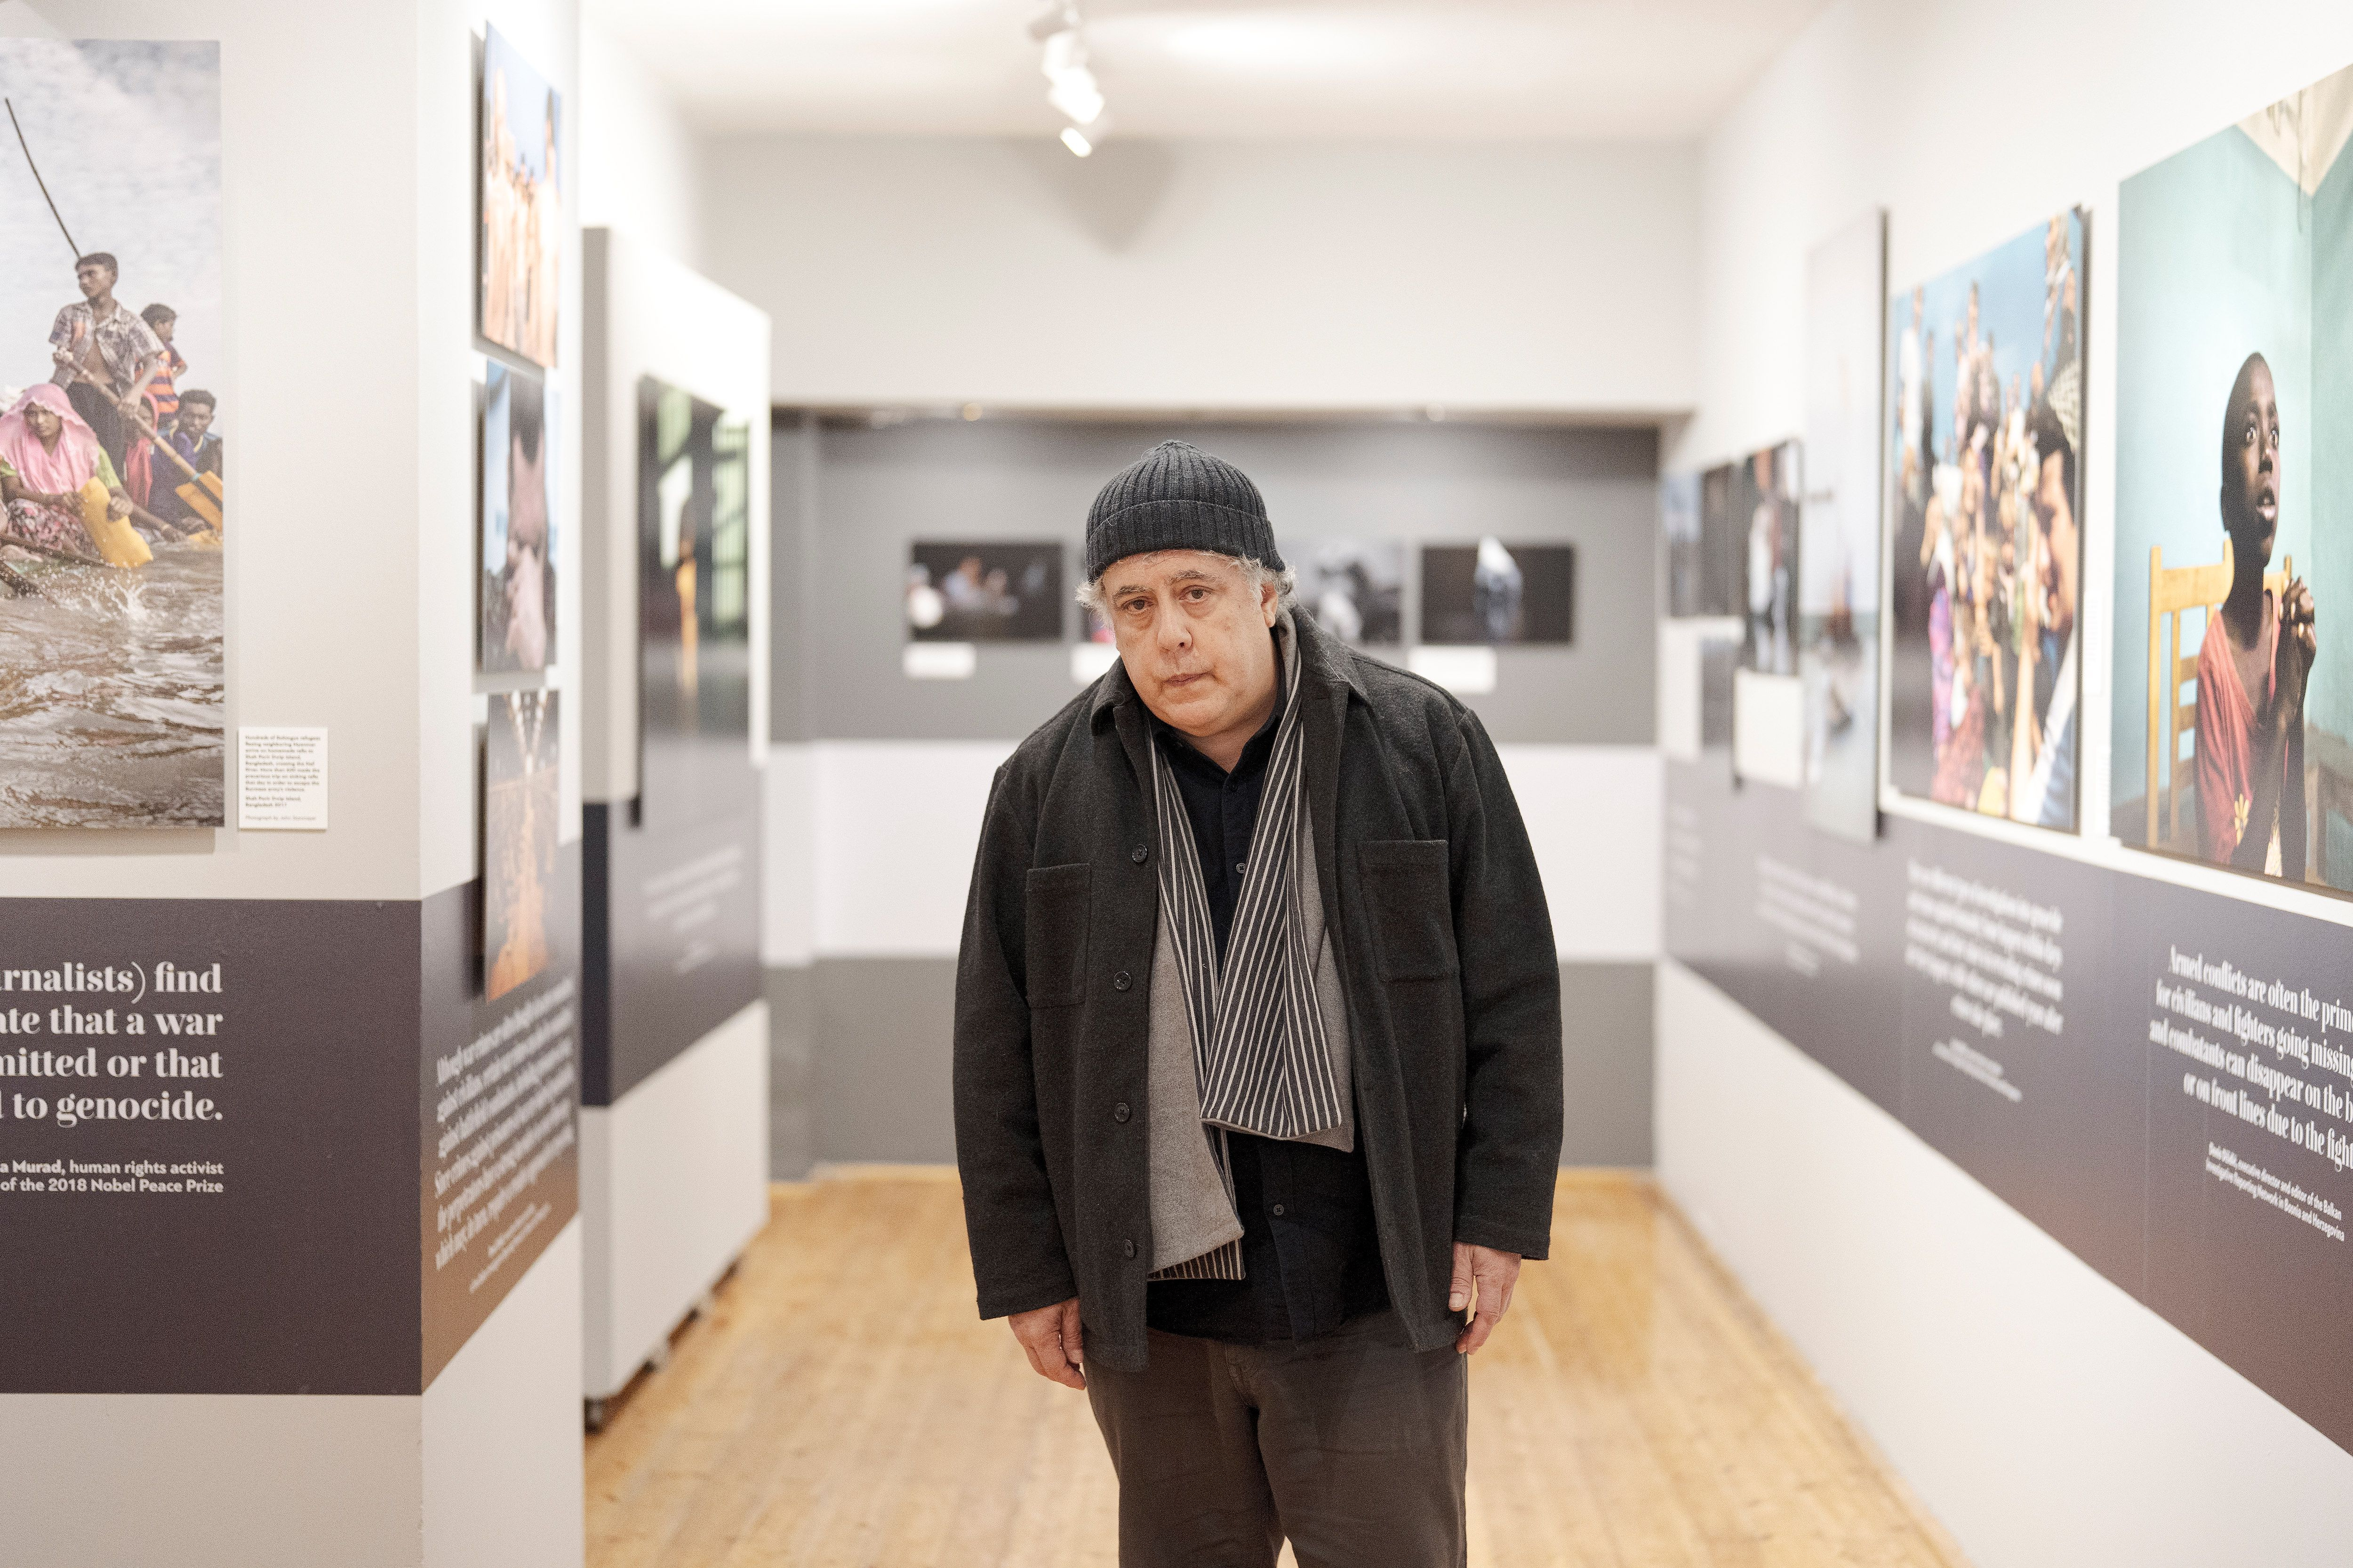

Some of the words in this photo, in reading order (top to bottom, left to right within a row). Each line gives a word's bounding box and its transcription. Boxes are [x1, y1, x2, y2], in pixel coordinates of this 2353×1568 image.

[0, 961, 145, 1004] rnalists)
[154, 961, 222, 993] find
[2168, 944, 2203, 982] Armed
[2203, 960, 2247, 997] conflicts
[2248, 977, 2266, 1003] are
[2268, 979, 2298, 1014] often
[2301, 988, 2319, 1021] the
[2321, 999, 2353, 1033] prim
[49, 1005, 118, 1035] that
[127, 1013, 146, 1035] a
[154, 1013, 224, 1035] war
[2212, 1004, 2233, 1033] and
[2234, 1005, 2275, 1048] fighters
[2276, 1026, 2309, 1070] going
[107, 1055, 146, 1077] or
[155, 1048, 223, 1078] that
[2169, 1028, 2225, 1070] combatants
[2226, 1051, 2245, 1078] can
[2247, 1053, 2304, 1102] disappear
[2305, 1084, 2321, 1110] on
[2324, 1084, 2343, 1119] the
[13, 1093, 48, 1120] to
[56, 1090, 223, 1128] genocide.
[2211, 1077, 2238, 1116] front
[2239, 1089, 2266, 1128] lines
[2267, 1103, 2289, 1139] due
[2291, 1116, 2304, 1145] to
[2305, 1120, 2325, 1155] the
[0, 1177, 17, 1192] of
[20, 1177, 44, 1192] the
[48, 1178, 86, 1192] 2018
[91, 1178, 136, 1192] Nobel
[140, 1179, 183, 1192] Peace
[187, 1179, 224, 1193] Prize
[13, 1159, 65, 1176] Murad,
[70, 1160, 120, 1174] human
[125, 1160, 166, 1177] rights
[171, 1160, 224, 1175] activist
[2313, 1195, 2323, 1211] the
[2323, 1199, 2342, 1221] Balkan
[2302, 1210, 2313, 1224] and
[2313, 1213, 2345, 1241] Herzegovina
